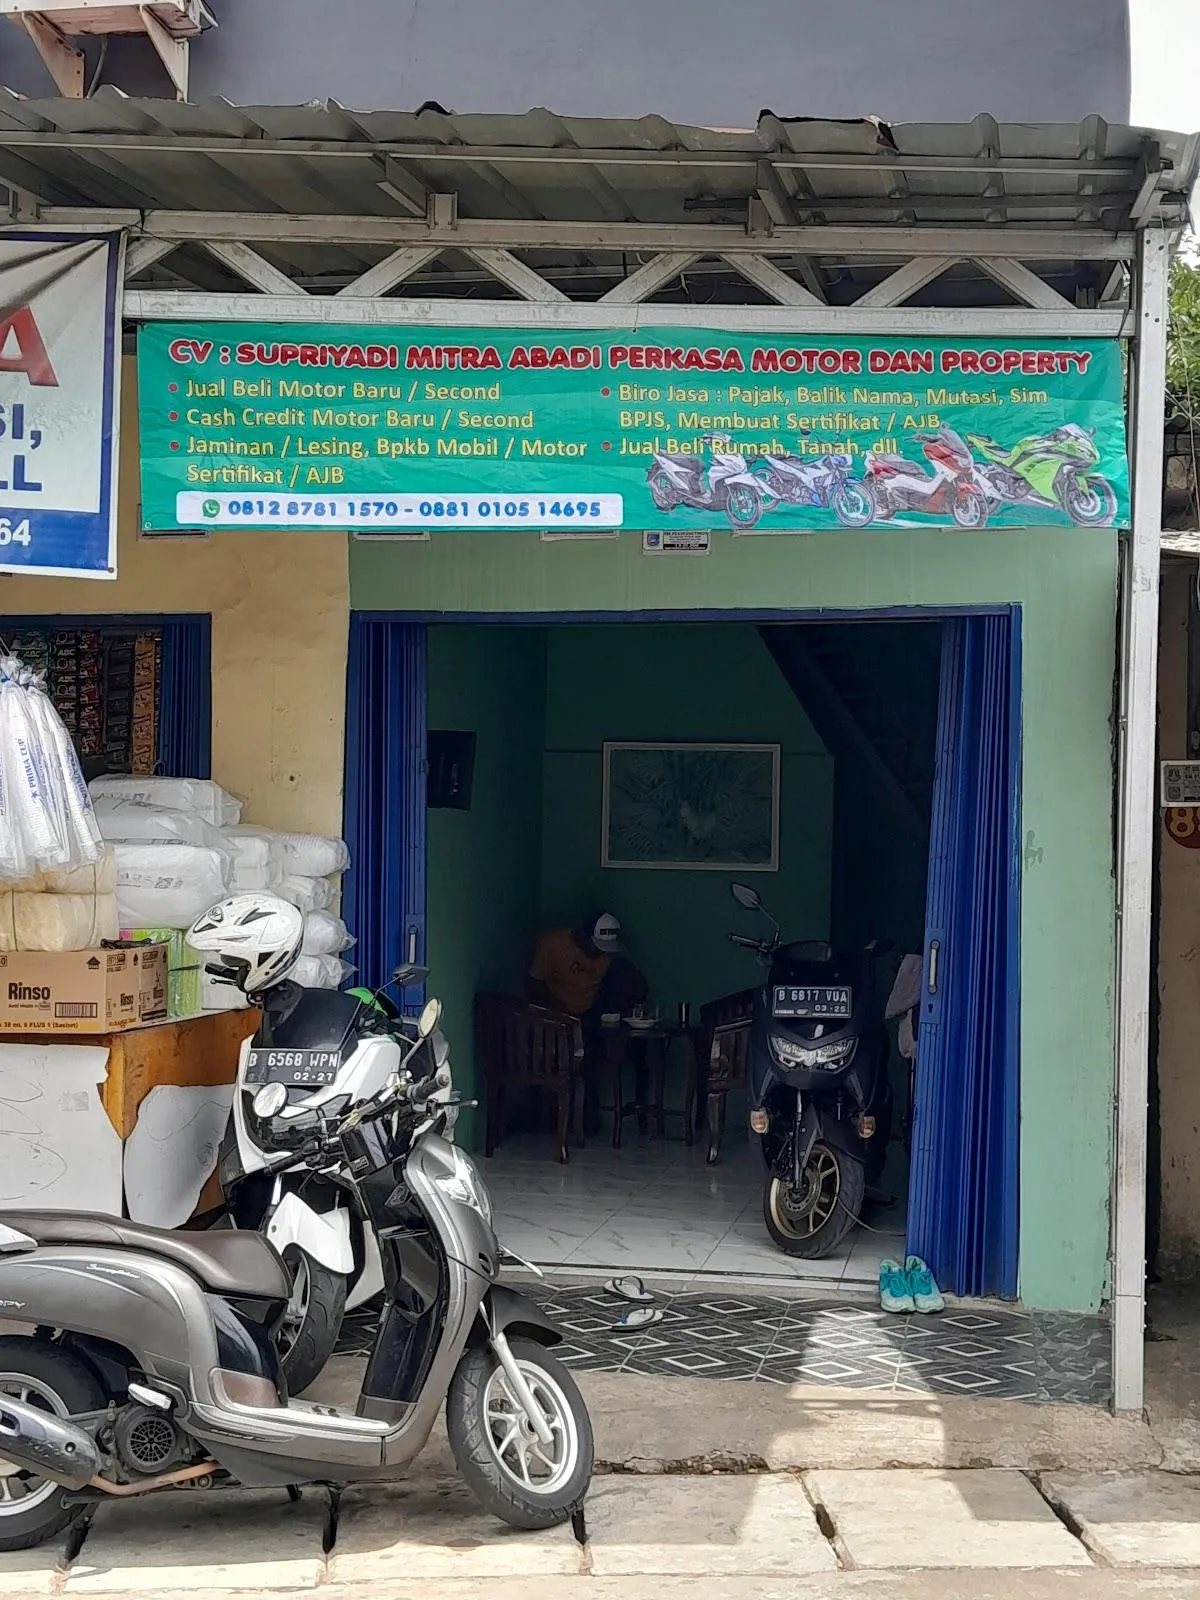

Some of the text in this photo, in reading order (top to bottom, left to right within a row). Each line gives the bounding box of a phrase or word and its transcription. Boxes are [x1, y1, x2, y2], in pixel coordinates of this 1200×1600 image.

[169, 339, 1092, 375] CV : SUPRIYADI MITRA ABADI PERKASA MOTOR DAN PROPERTY
[186, 379, 500, 403] Jual Beli Motor Baru / Second
[619, 384, 661, 402] Biro
[667, 385, 709, 402] Jasa
[728, 386, 790, 408] Pajak,
[797, 386, 846, 404] Balik
[852, 388, 919, 408] Nama,
[926, 388, 1004, 406] Mutasi,
[1010, 387, 1048, 404] Sim
[0, 403, 42, 450] I,
[186, 408, 534, 431] Cash Credit Motor Baru / Second
[619, 411, 941, 433] BPJS, Membuat Sertifikat / AJB
[186, 435, 588, 460] Jaminan / Lesing, Bpkb Mobil / Motor
[619, 437, 660, 455] Jual
[666, 438, 704, 455] Beli
[711, 439, 791, 457] Rumah,
[797, 439, 865, 457] Tanah,
[0, 455, 42, 492] L
[186, 464, 344, 488] Sertifikat / AJB
[228, 500, 280, 516] 0812
[287, 501, 336, 516] 8781
[347, 501, 398, 517] 1570
[419, 501, 469, 517] 0881
[478, 501, 529, 517] 0105
[538, 501, 601, 517] 14695
[8, 981, 51, 1001] Rinso
[779, 990, 786, 1001] B
[826, 990, 847, 1002] VUA
[248, 1052, 338, 1068] B 6568 WPN
